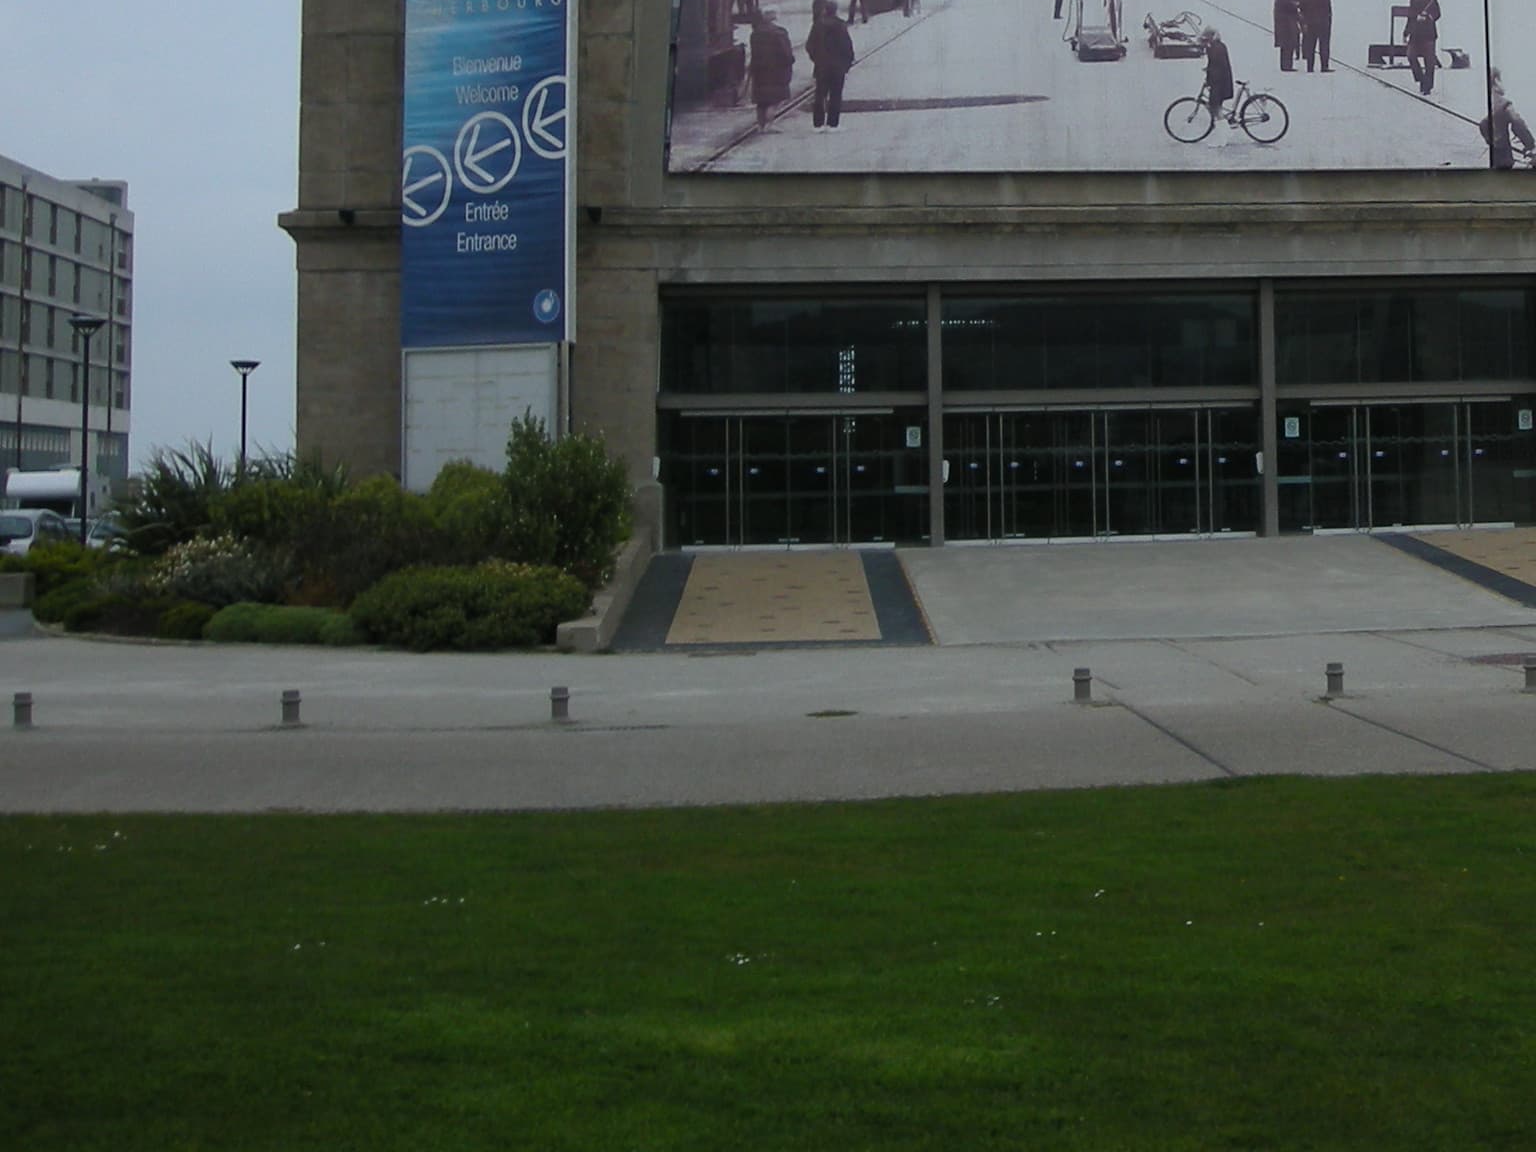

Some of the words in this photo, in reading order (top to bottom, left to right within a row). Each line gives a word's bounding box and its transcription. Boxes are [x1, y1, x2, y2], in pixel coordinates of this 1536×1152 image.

[452, 54, 522, 76] Bienvenue
[455, 84, 519, 105] Welcome
[465, 200, 509, 223] Entrée
[456, 232, 517, 253] Entrance
